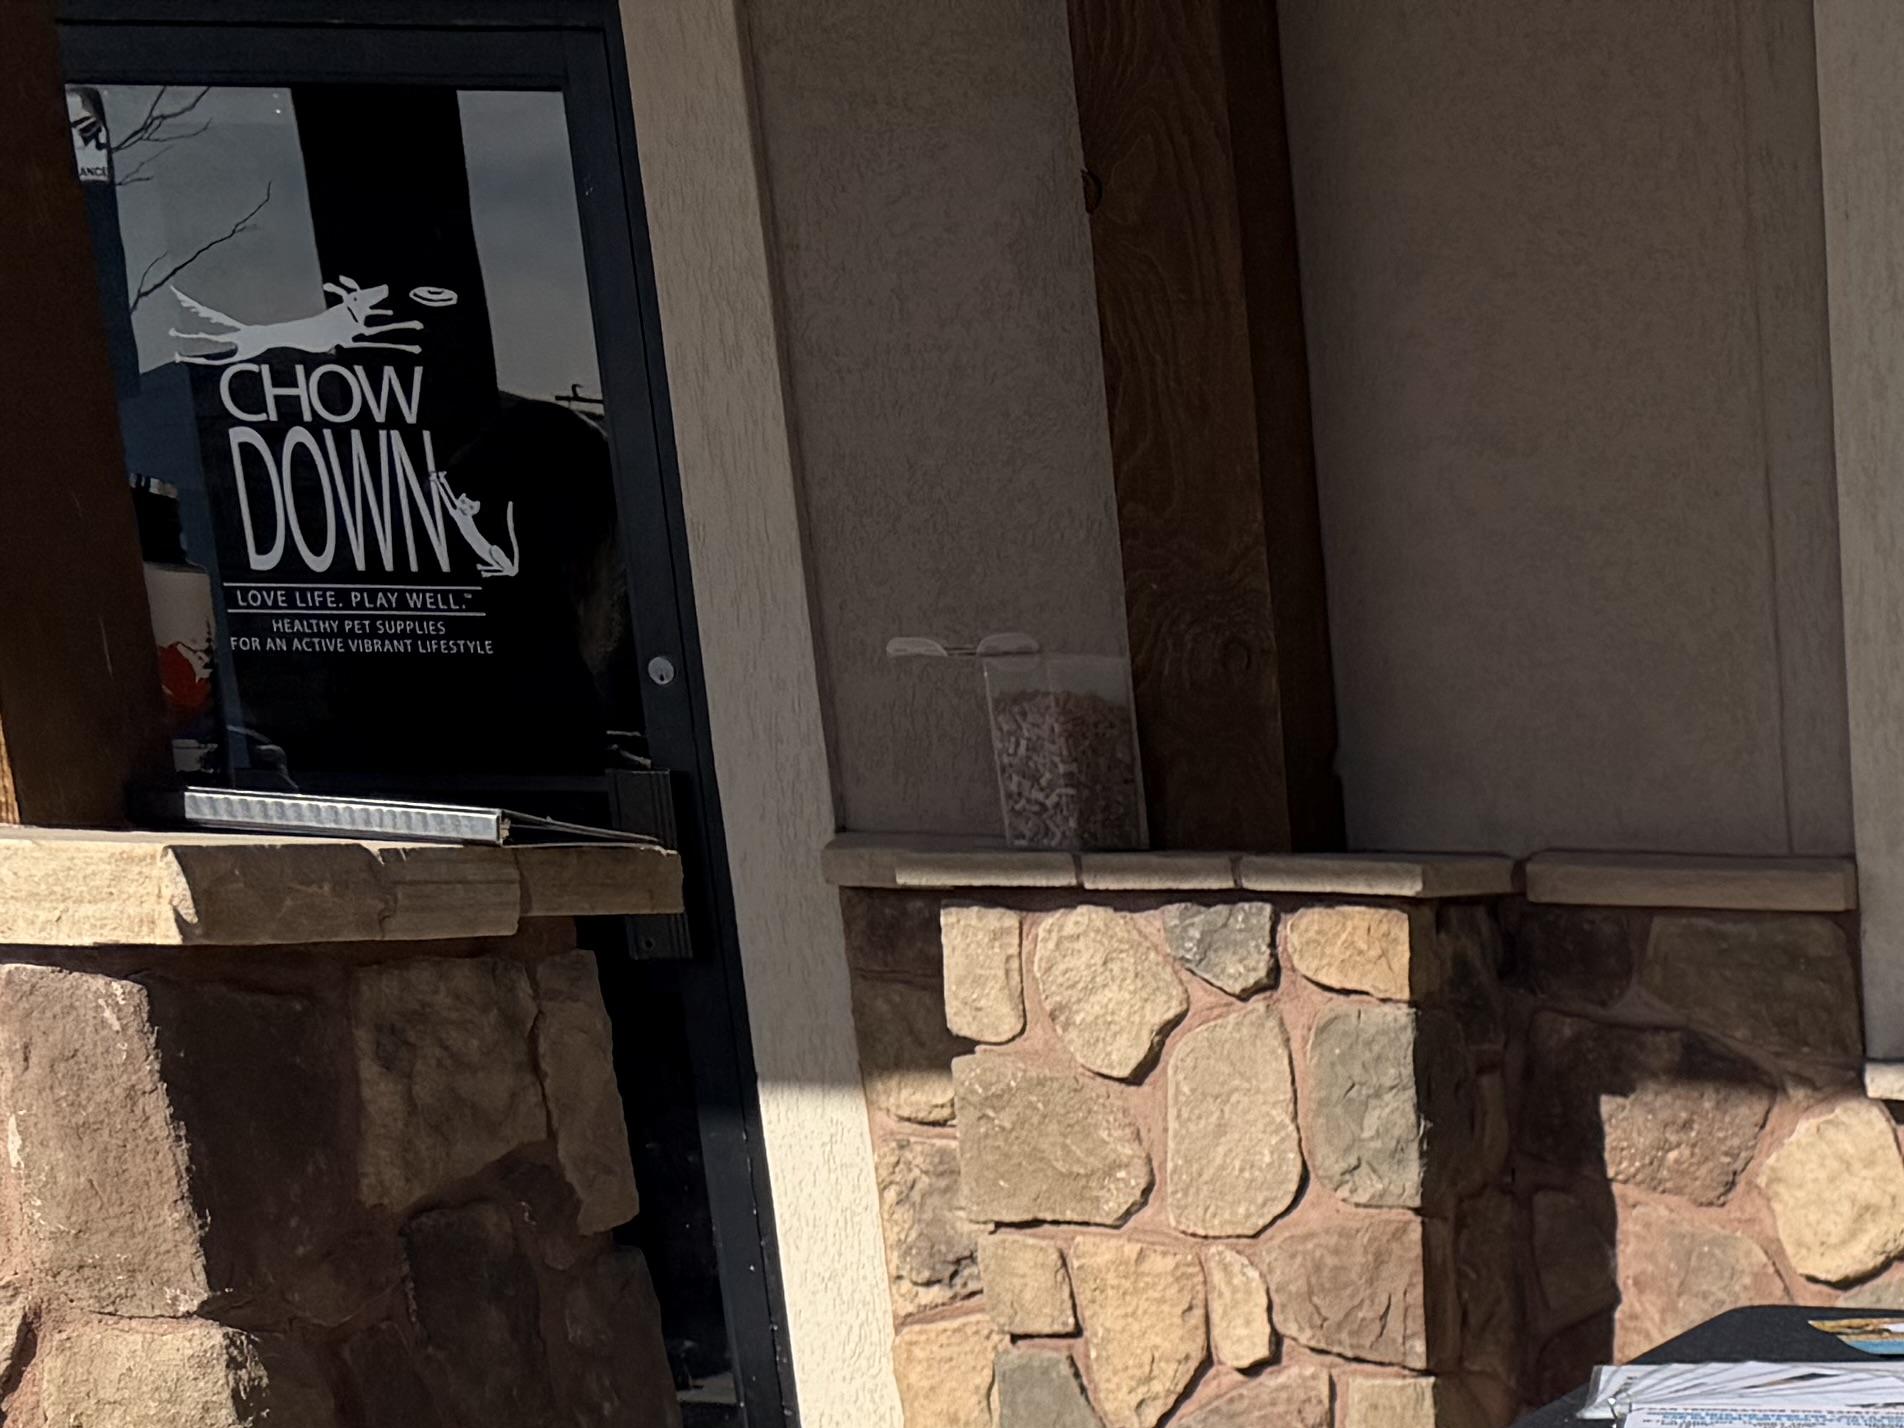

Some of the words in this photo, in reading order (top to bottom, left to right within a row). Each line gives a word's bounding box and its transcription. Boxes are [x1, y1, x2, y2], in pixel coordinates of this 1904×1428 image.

[219, 362, 424, 424] CHOW
[228, 425, 452, 573] DOWN
[236, 589, 288, 607] LOVE
[295, 590, 343, 608] LIFE.
[351, 591, 398, 609] PLAY
[272, 618, 340, 634] HEALTHY
[344, 620, 371, 635] PET
[376, 620, 446, 636] SUPPLIES
[229, 636, 261, 651] FOR
[266, 637, 288, 651] AN
[292, 638, 345, 653] ACTIVE
[348, 639, 413, 653] VIBRANT
[417, 640, 494, 655] LIFESTYLE
